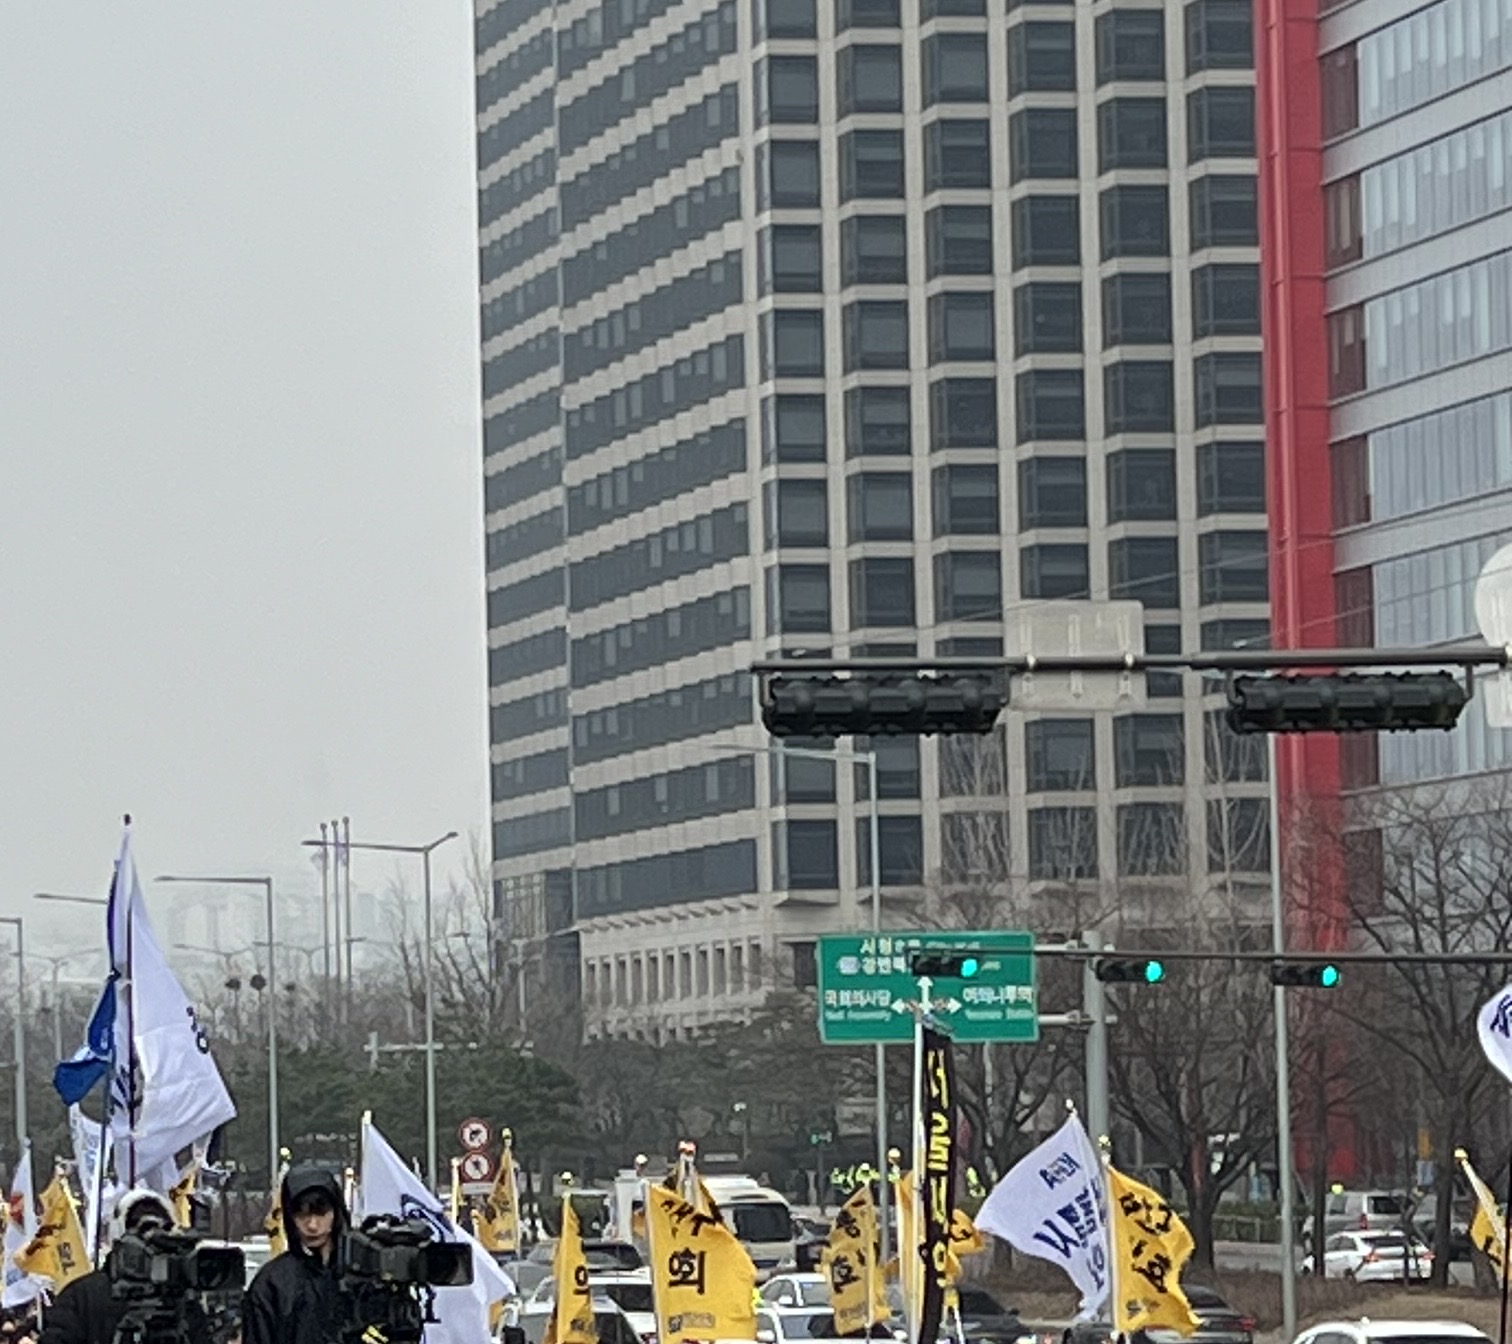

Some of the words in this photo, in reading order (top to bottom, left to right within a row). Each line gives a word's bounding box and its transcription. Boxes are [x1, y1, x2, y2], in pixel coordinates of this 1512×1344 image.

[862, 956, 912, 975] 강변북
[824, 989, 891, 1007] 국회의사당
[962, 985, 1033, 1005] 여의나루역
